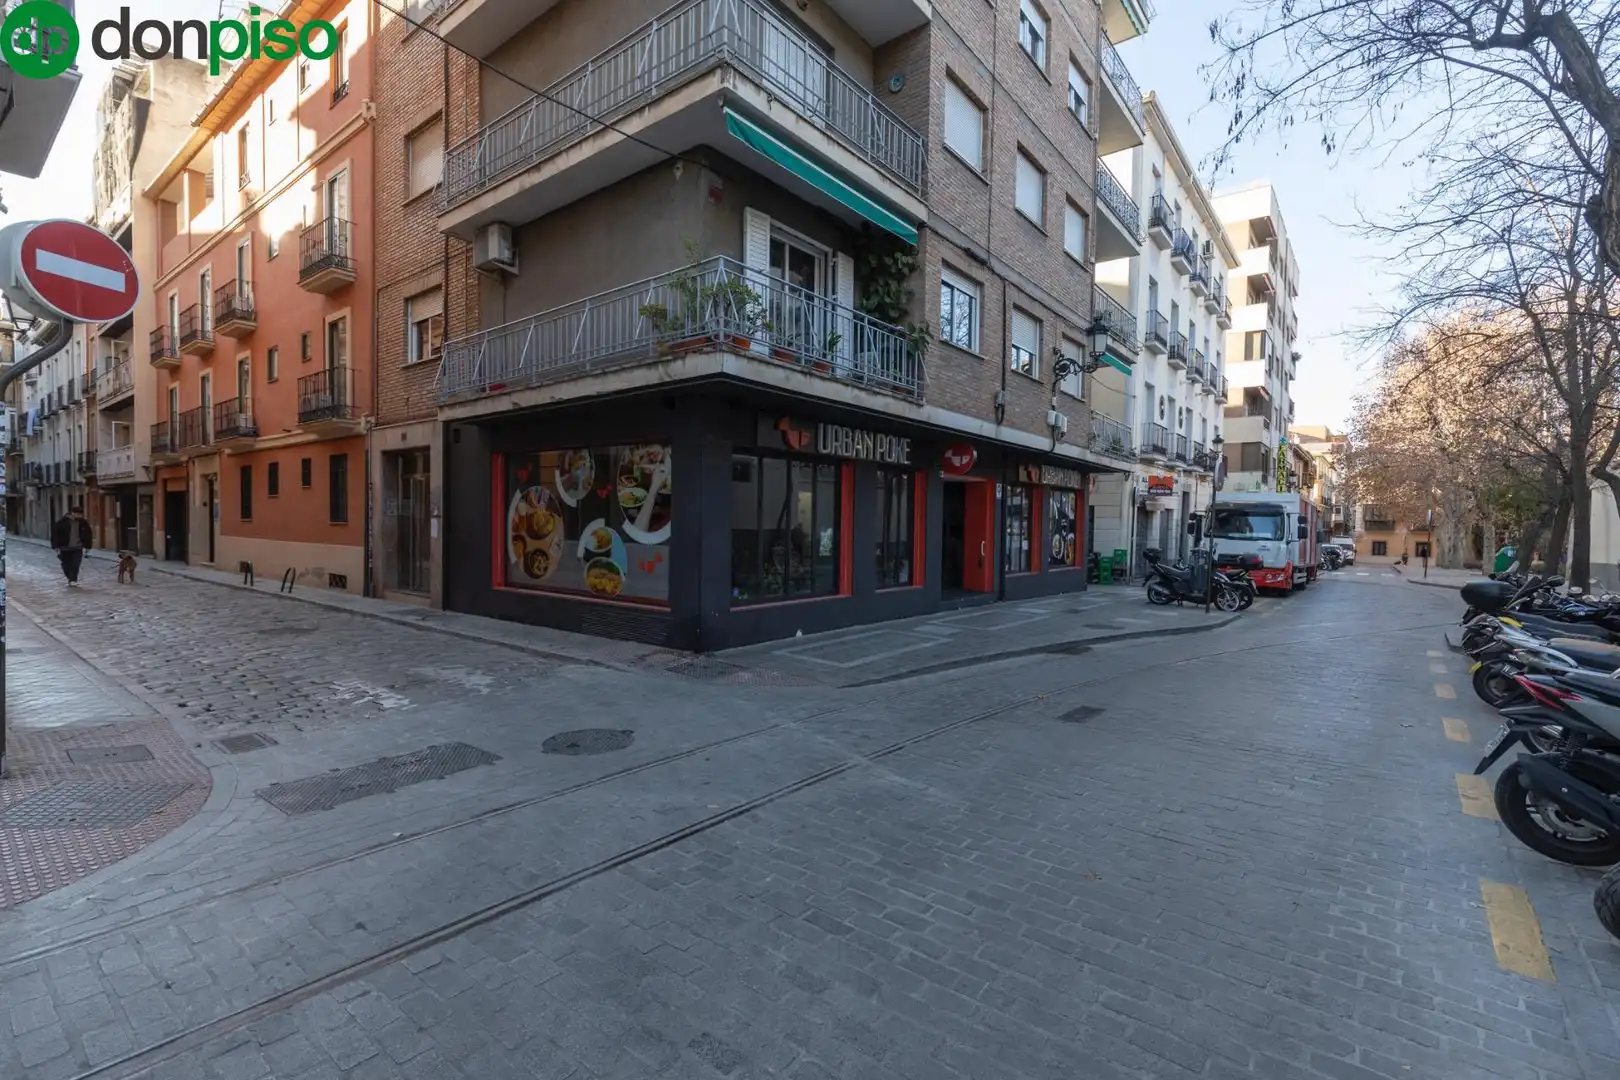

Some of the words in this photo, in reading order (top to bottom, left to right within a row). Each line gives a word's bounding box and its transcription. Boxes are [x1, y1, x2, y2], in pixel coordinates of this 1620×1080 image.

[817, 422, 874, 460] URBAN
[875, 433, 912, 465] POKE
[1277, 445, 1287, 492] FARMACI
